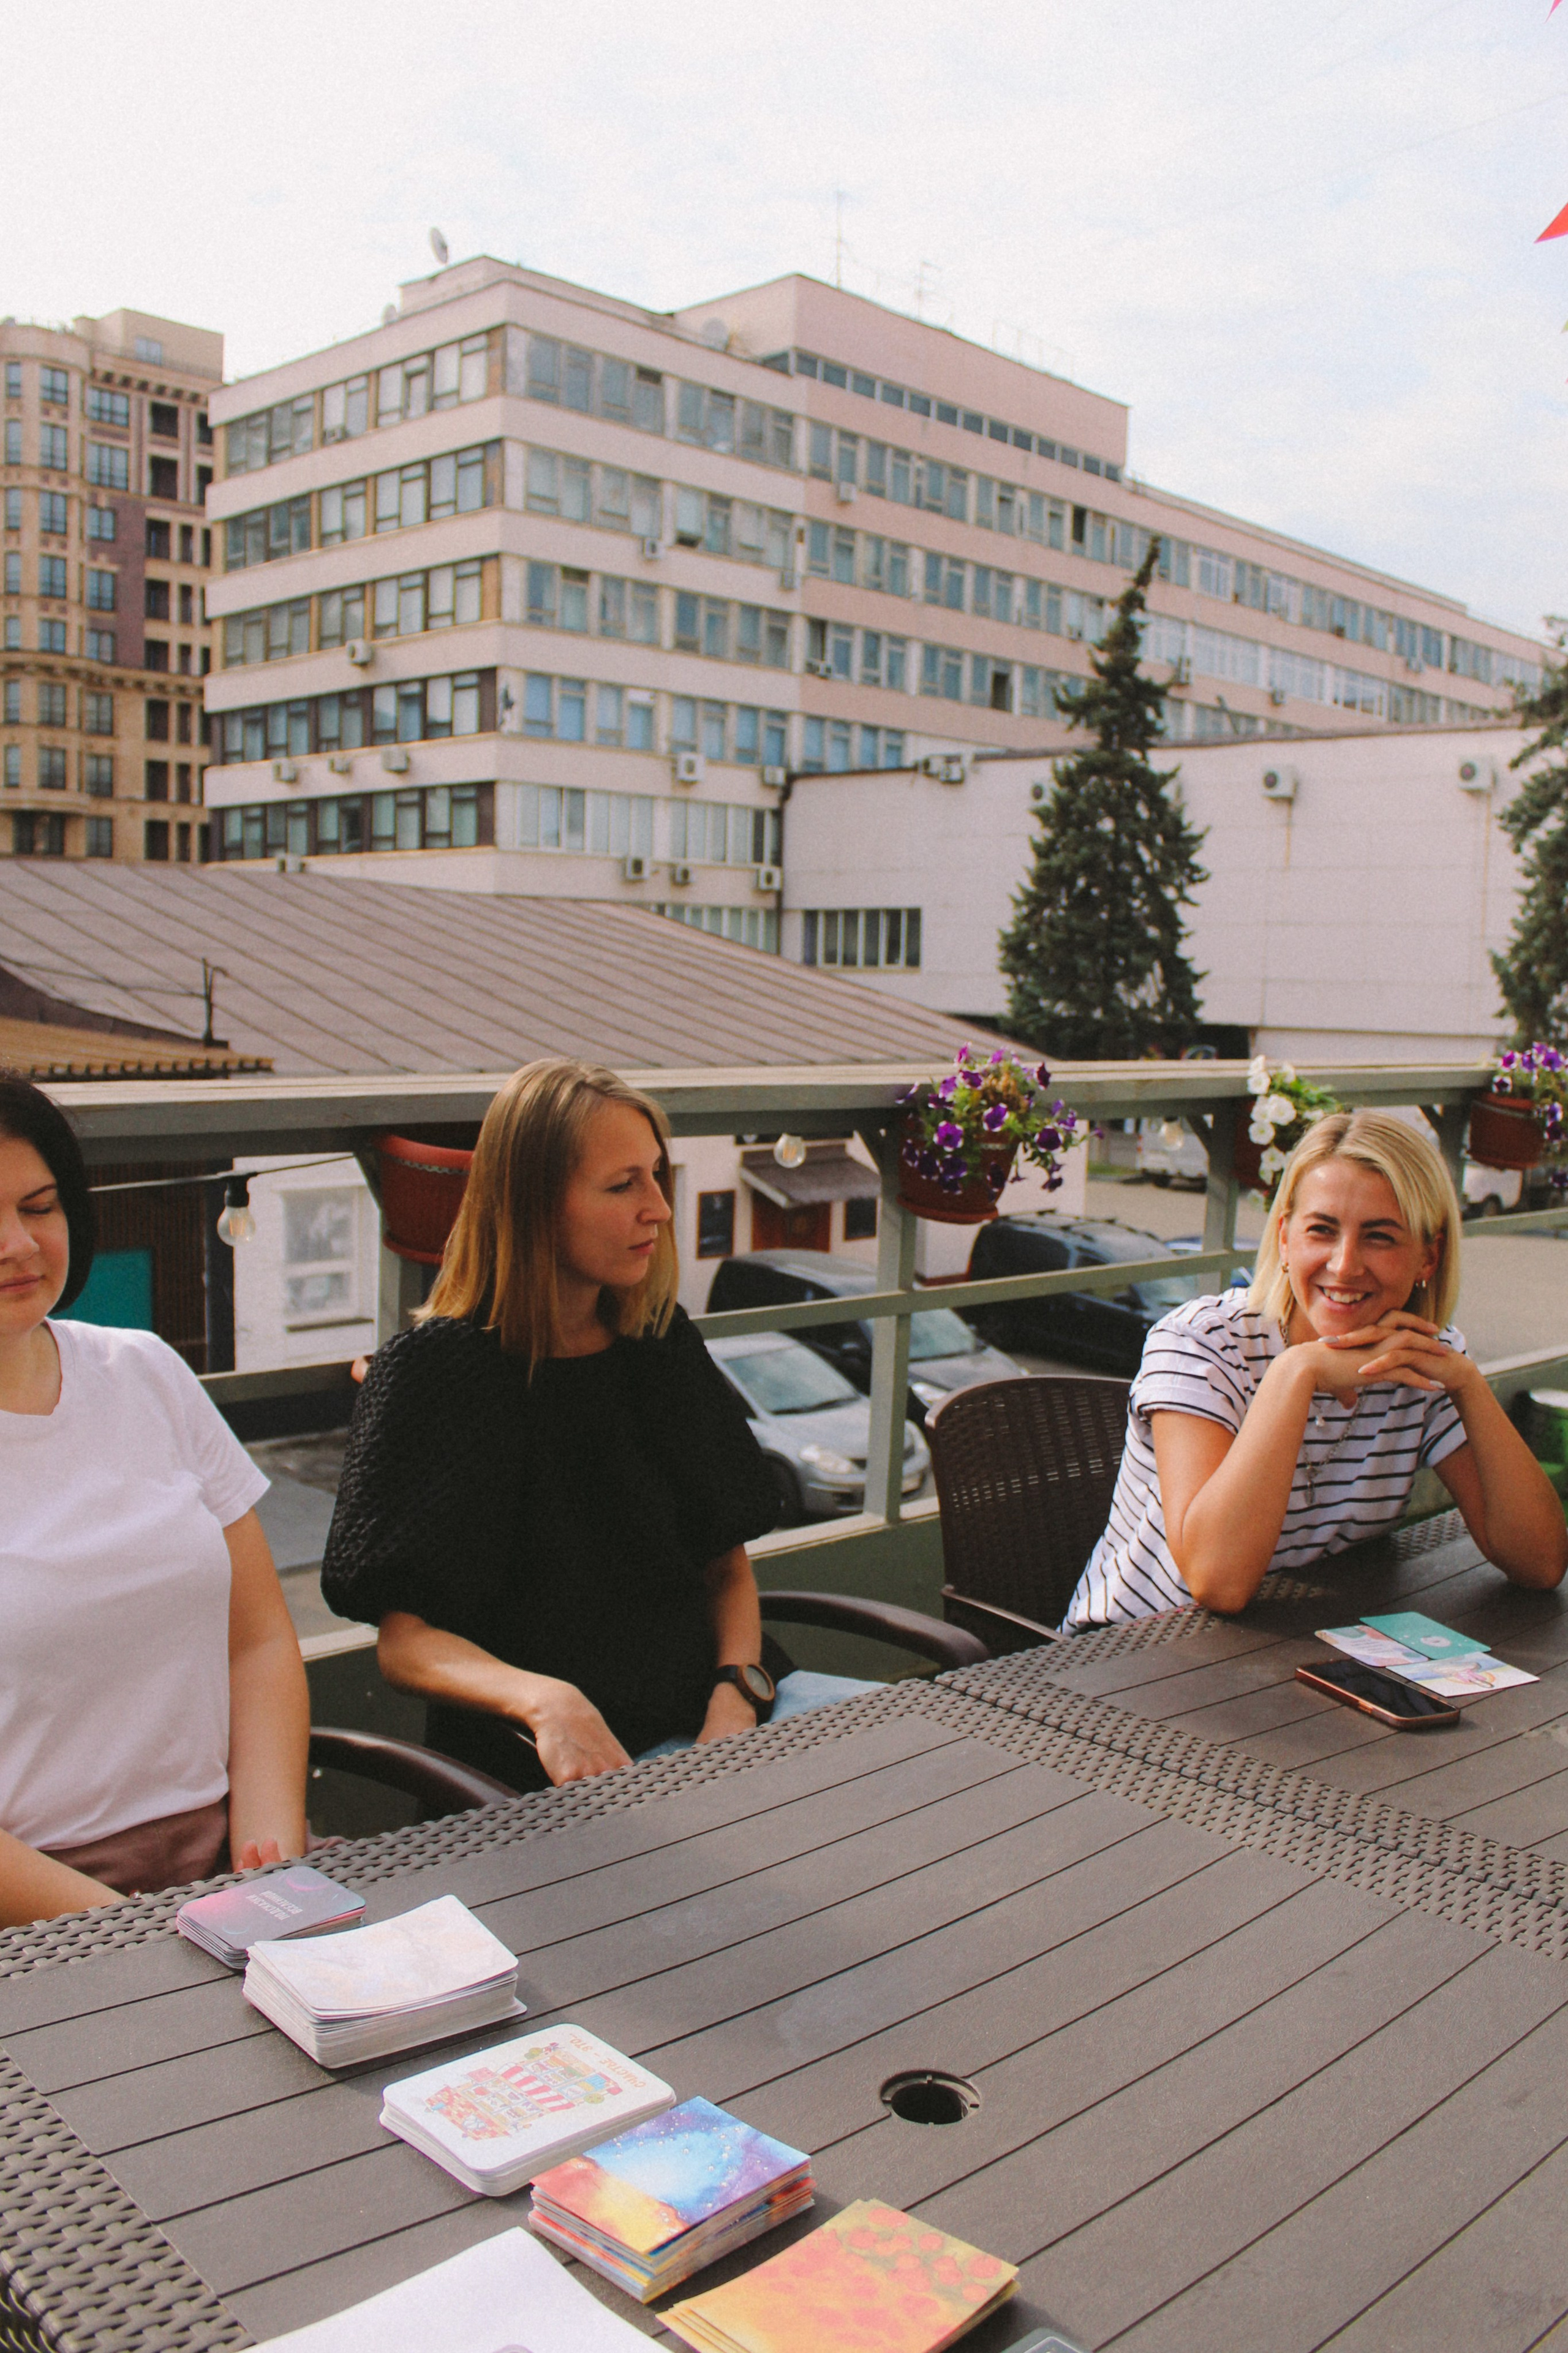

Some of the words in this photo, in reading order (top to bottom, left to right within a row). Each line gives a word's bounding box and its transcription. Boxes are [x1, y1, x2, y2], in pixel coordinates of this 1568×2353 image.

[246, 1894, 290, 1920] ПОДСКАЗКИ
[259, 1890, 303, 1914] ВСЕЛЕННОЙ
[600, 2058, 646, 2088] СЧАСТЬЕ
